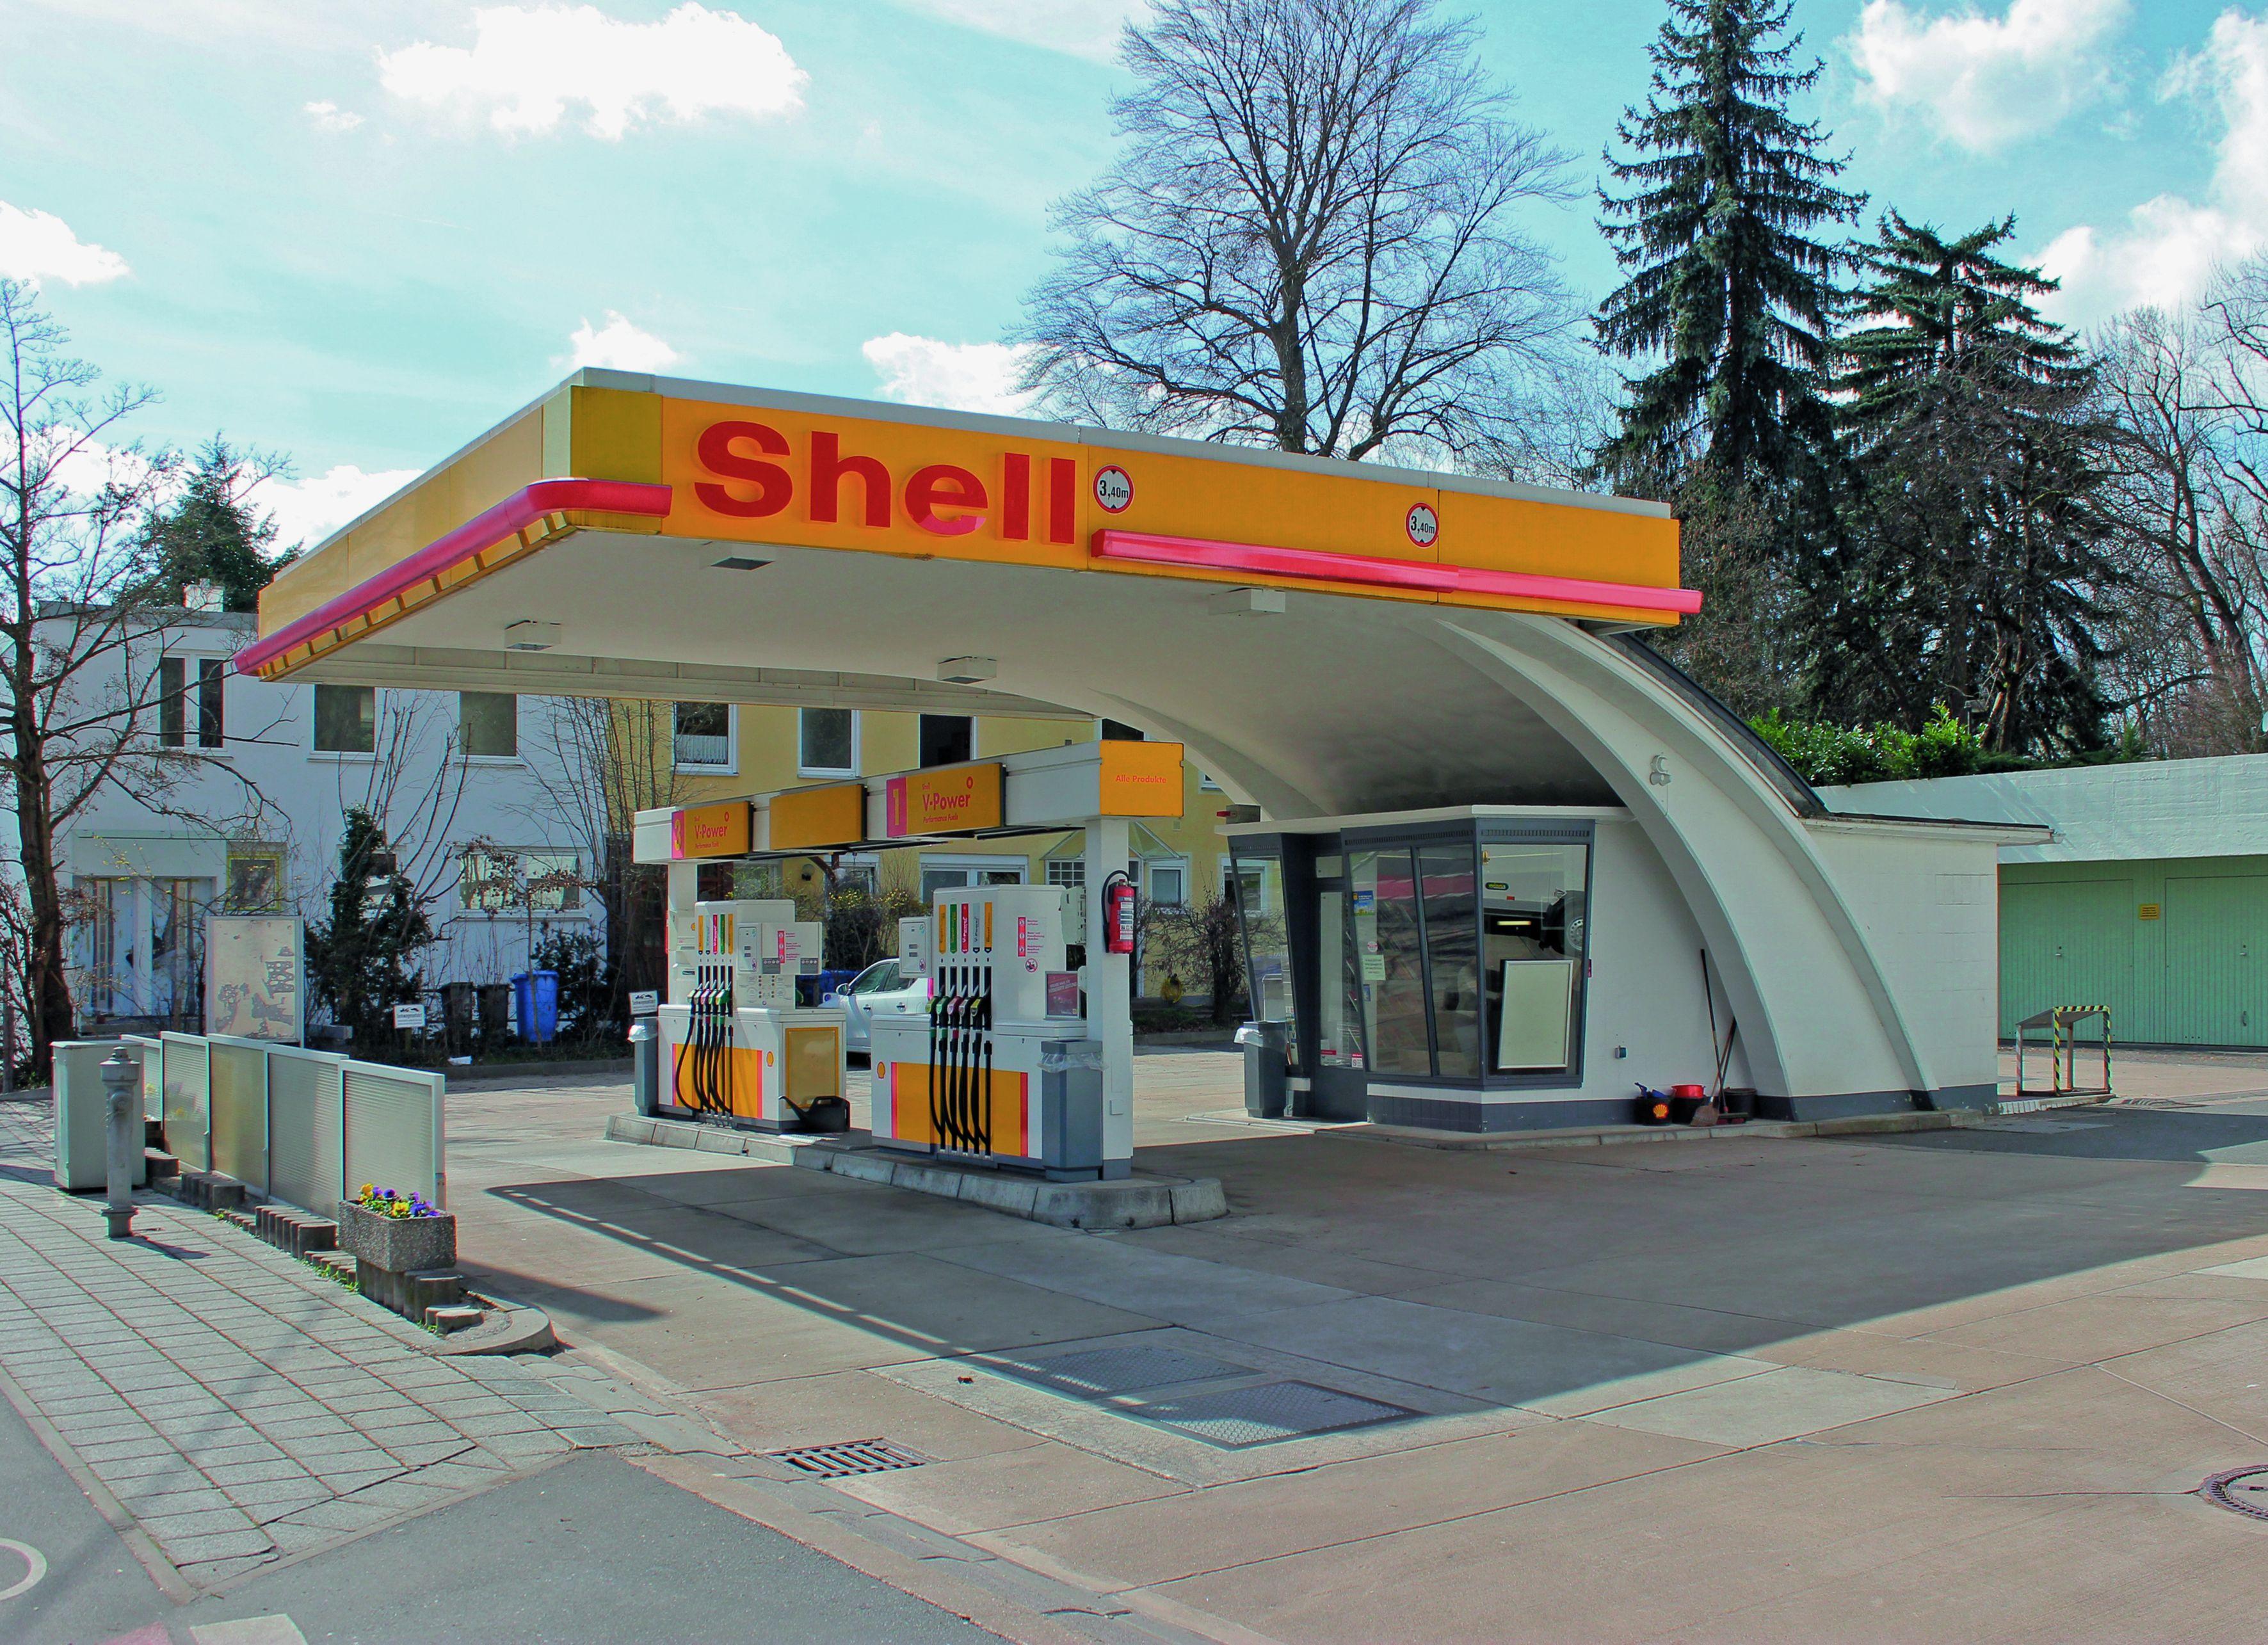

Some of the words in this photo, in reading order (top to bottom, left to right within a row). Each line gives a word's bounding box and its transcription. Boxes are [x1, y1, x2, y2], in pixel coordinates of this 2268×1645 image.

[694, 420, 1075, 545] Shell
[1099, 479, 1129, 500] 3,40m
[1410, 515, 1435, 534] 3,40m
[1132, 775, 1166, 783] Produkte
[922, 792, 970, 812] V-Power
[675, 819, 682, 851] 3
[695, 824, 727, 839] V-Power
